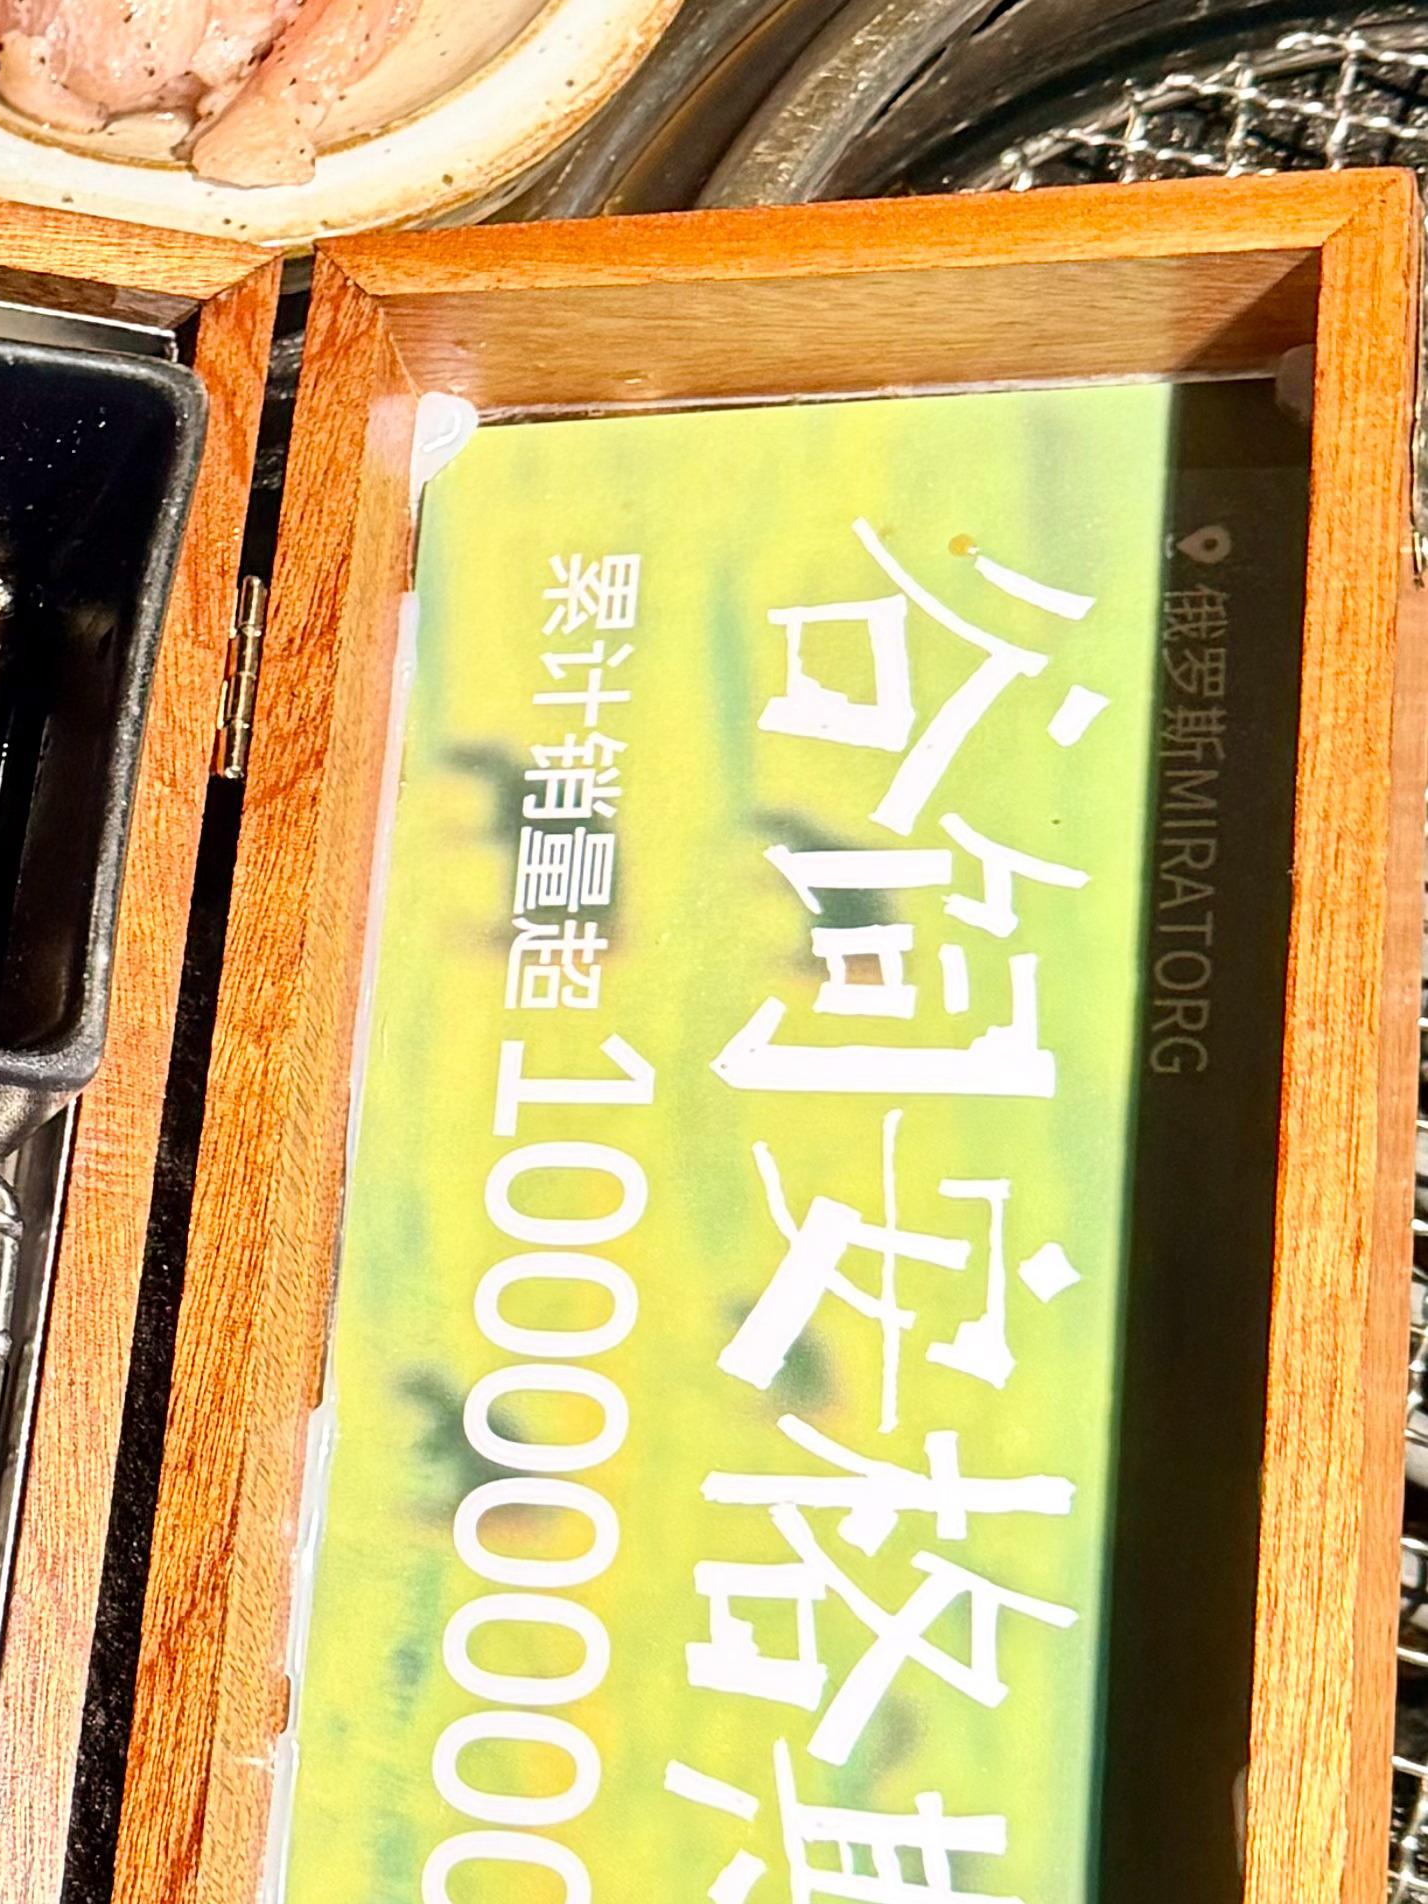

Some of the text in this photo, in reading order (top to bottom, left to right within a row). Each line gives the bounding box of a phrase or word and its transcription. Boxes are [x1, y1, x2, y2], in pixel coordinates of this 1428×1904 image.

[501, 550, 642, 1012] 累计销量超
